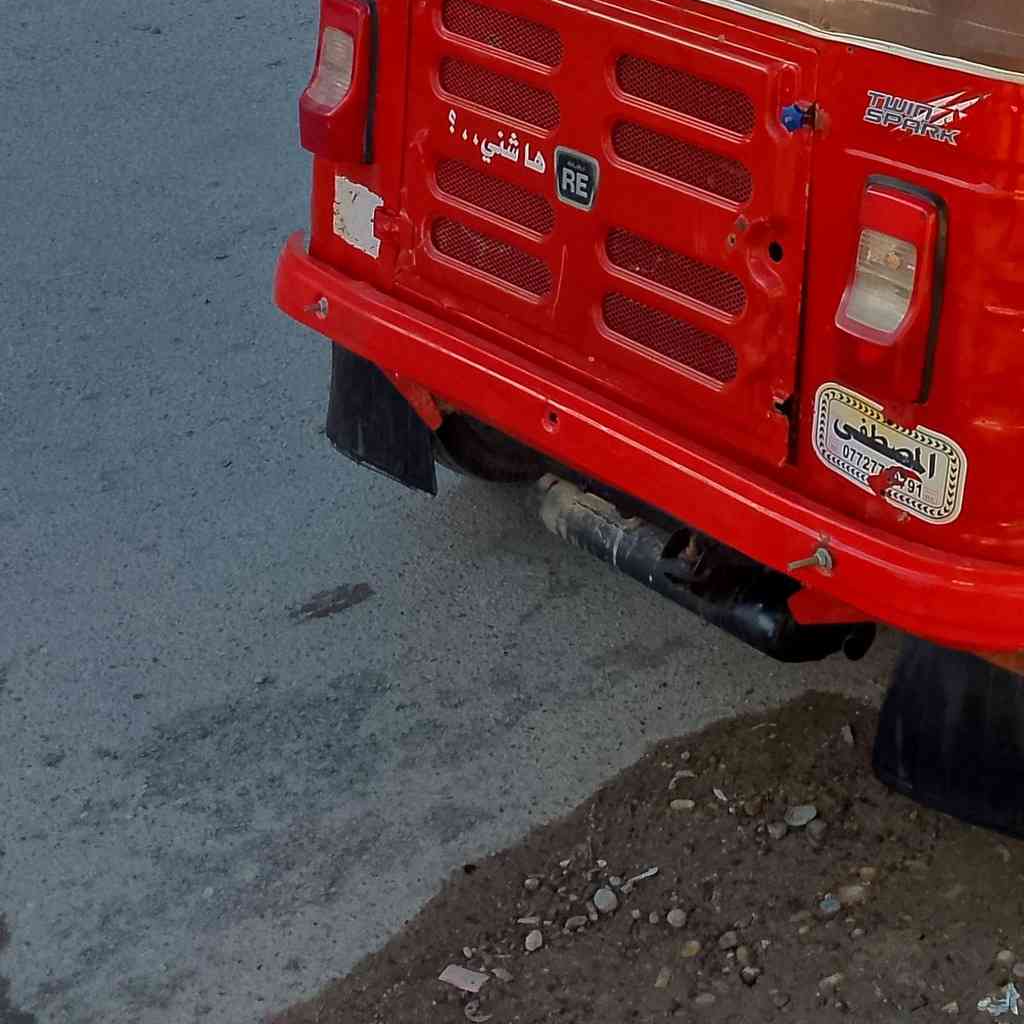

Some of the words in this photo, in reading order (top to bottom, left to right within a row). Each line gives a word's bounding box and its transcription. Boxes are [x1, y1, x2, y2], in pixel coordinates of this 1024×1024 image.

[866, 89, 933, 122] TWIN
[863, 107, 961, 146] SPARK
[524, 142, 546, 174] ها
[561, 167, 589, 198] RE
